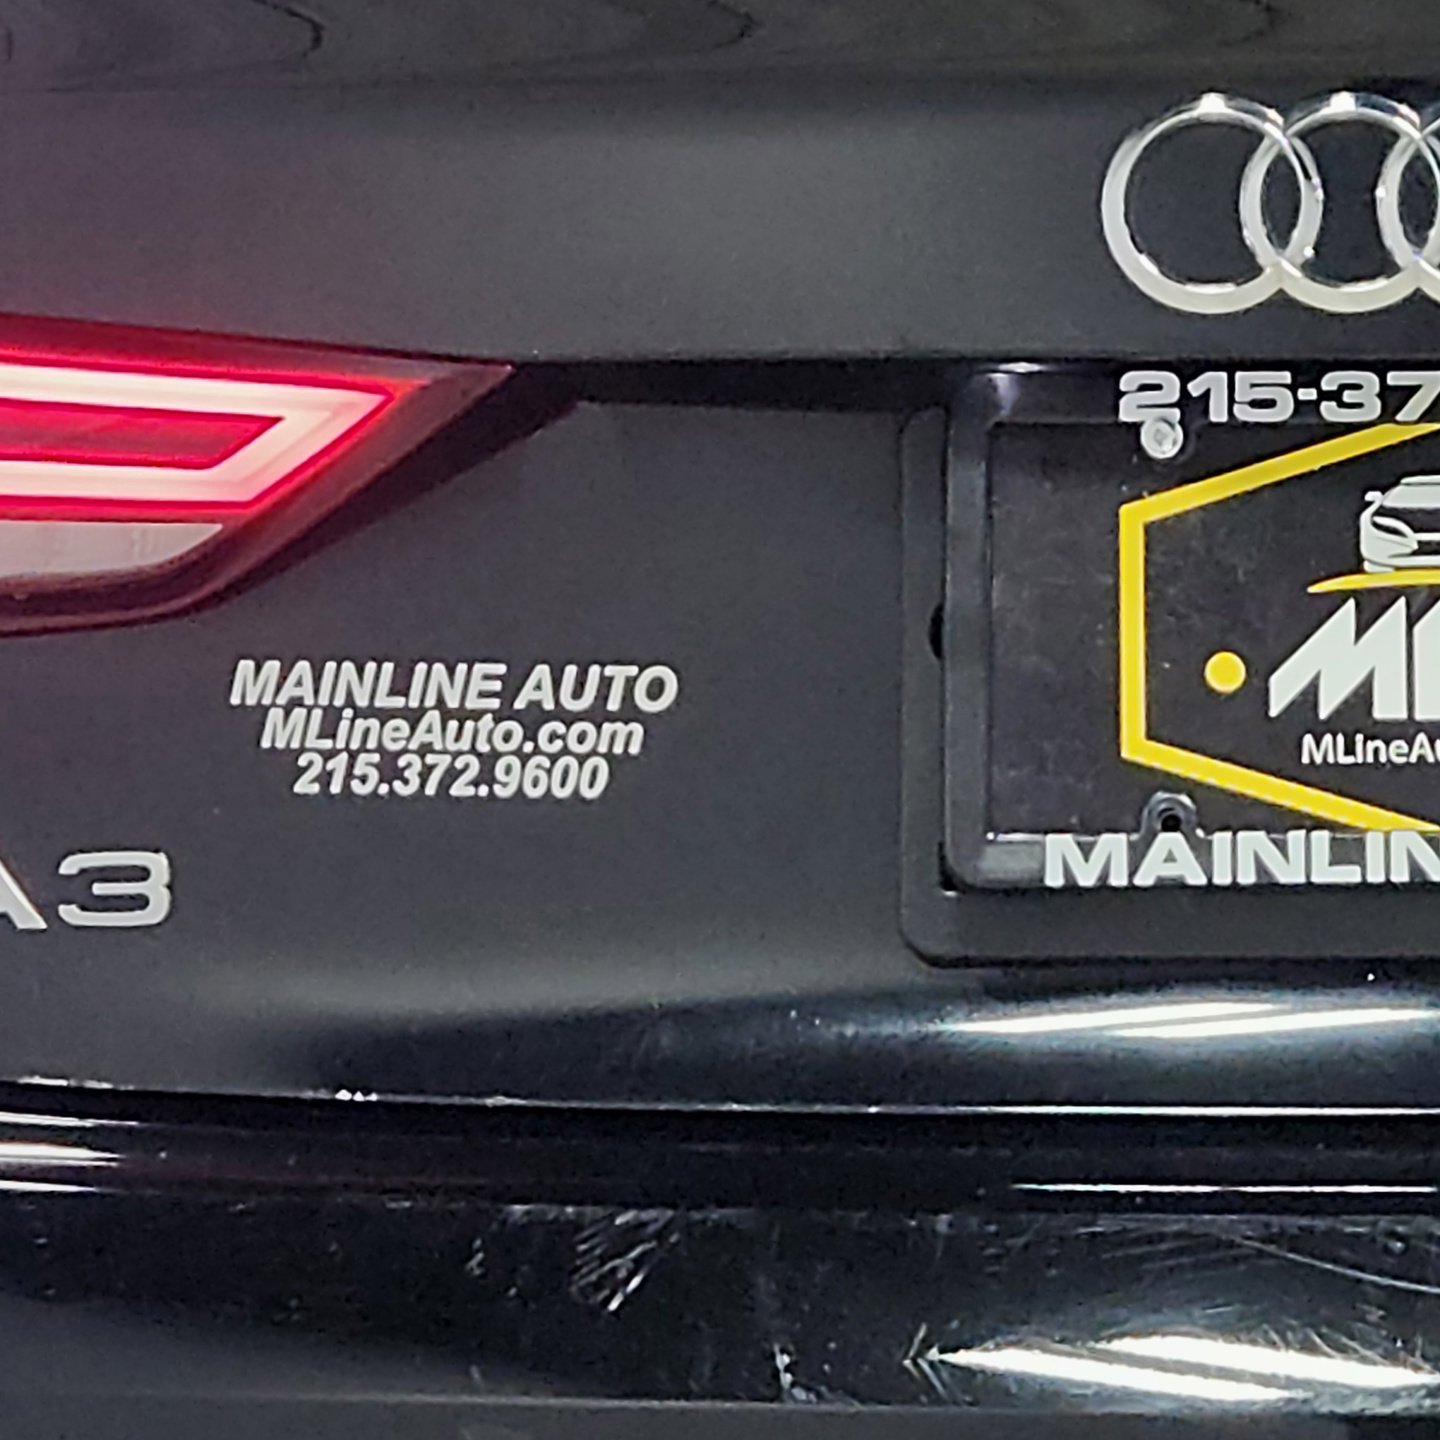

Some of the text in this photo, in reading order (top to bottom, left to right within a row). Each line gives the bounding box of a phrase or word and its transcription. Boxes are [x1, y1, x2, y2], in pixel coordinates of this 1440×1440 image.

[229, 659, 679, 713] MAINLINE AUTO
[259, 706, 644, 756] MLineAuto.com
[292, 752, 609, 800] 215.372.9600
